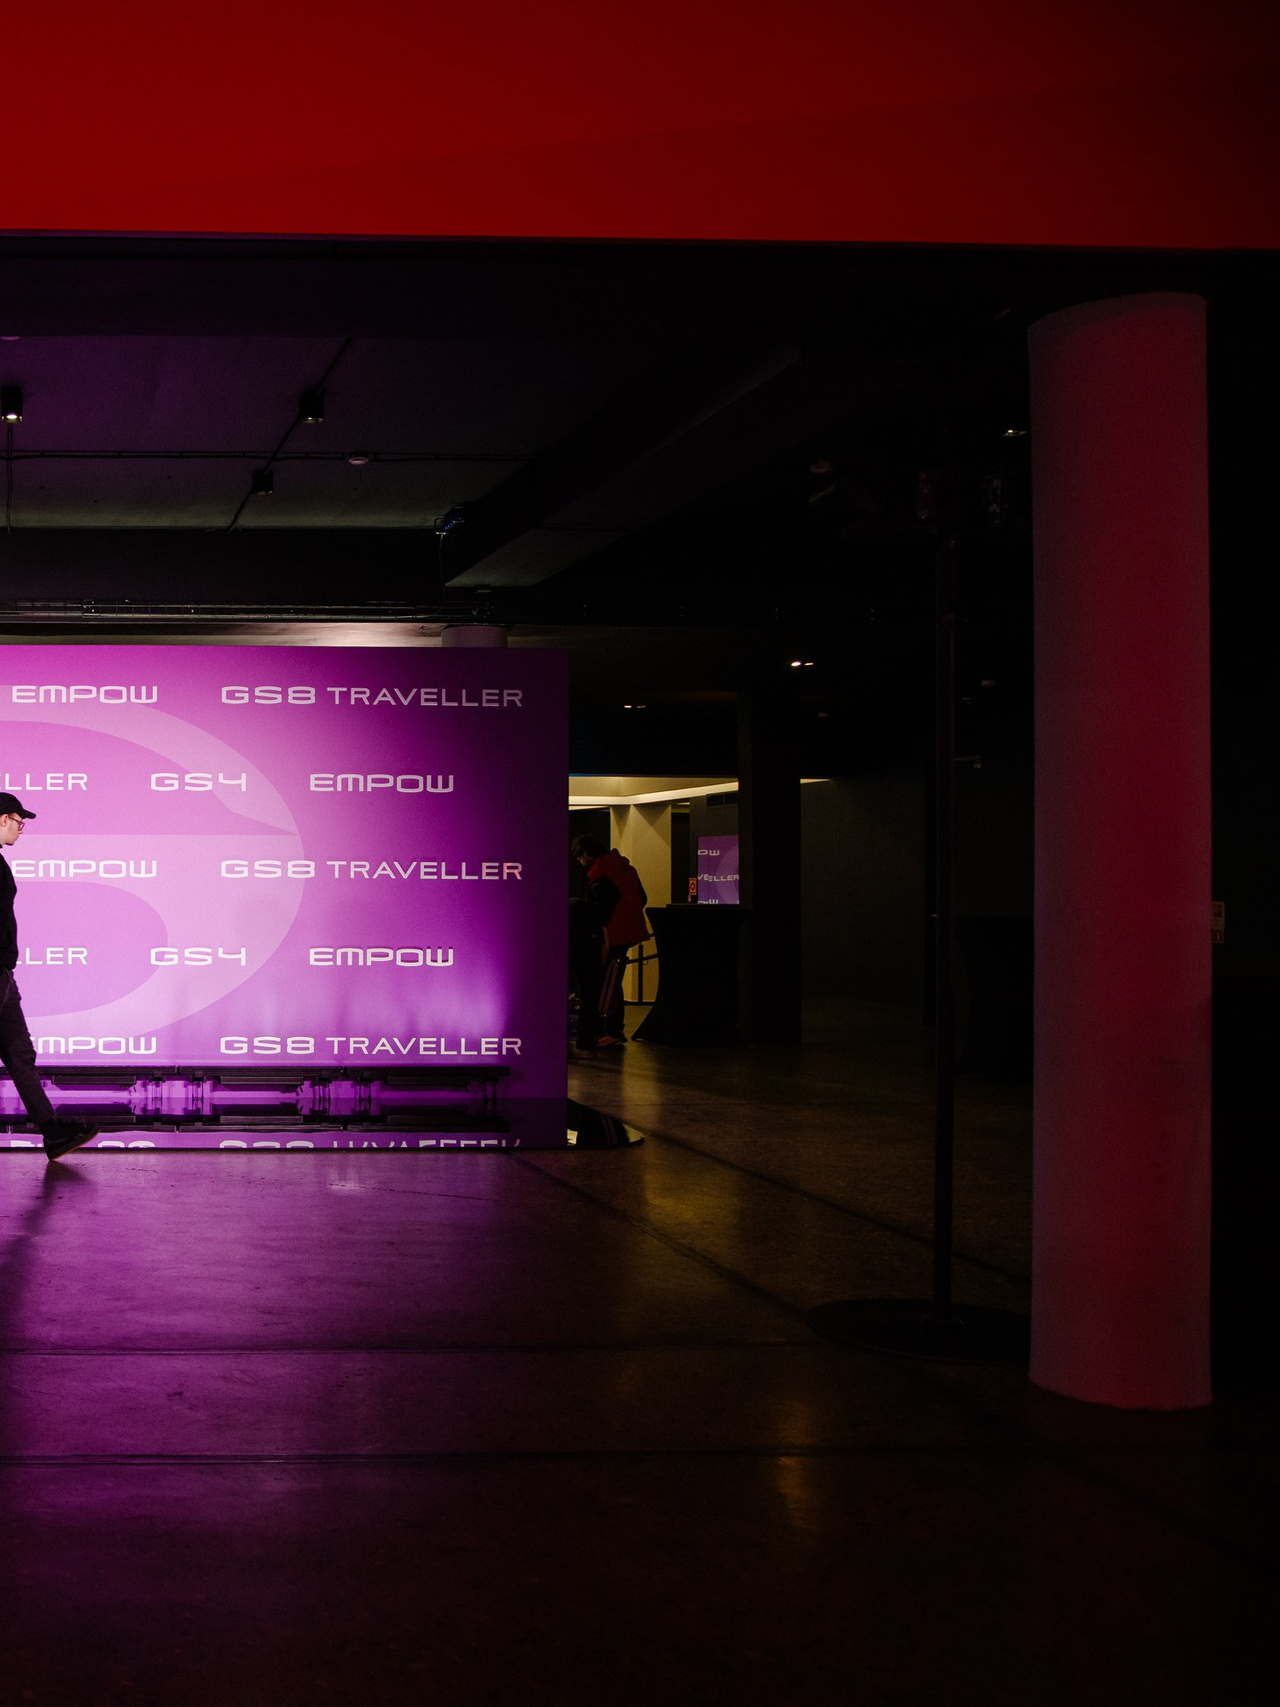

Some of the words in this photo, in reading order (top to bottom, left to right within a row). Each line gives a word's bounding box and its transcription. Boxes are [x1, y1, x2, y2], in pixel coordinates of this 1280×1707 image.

[11, 685, 158, 704] EMPOW
[221, 685, 315, 705] GS8
[326, 687, 523, 707] TRAVELLER
[150, 772, 247, 792] GS4
[309, 773, 454, 793] EMPOW
[11, 859, 157, 879] EMPOW
[220, 859, 315, 879] GS8
[326, 860, 522, 881] TRAVELLER
[150, 946, 247, 966] GS4
[309, 946, 455, 967] EMPOW
[29, 1036, 157, 1055] MPOW
[220, 1036, 315, 1055] GS8
[325, 1037, 522, 1056] TRAVELLER
